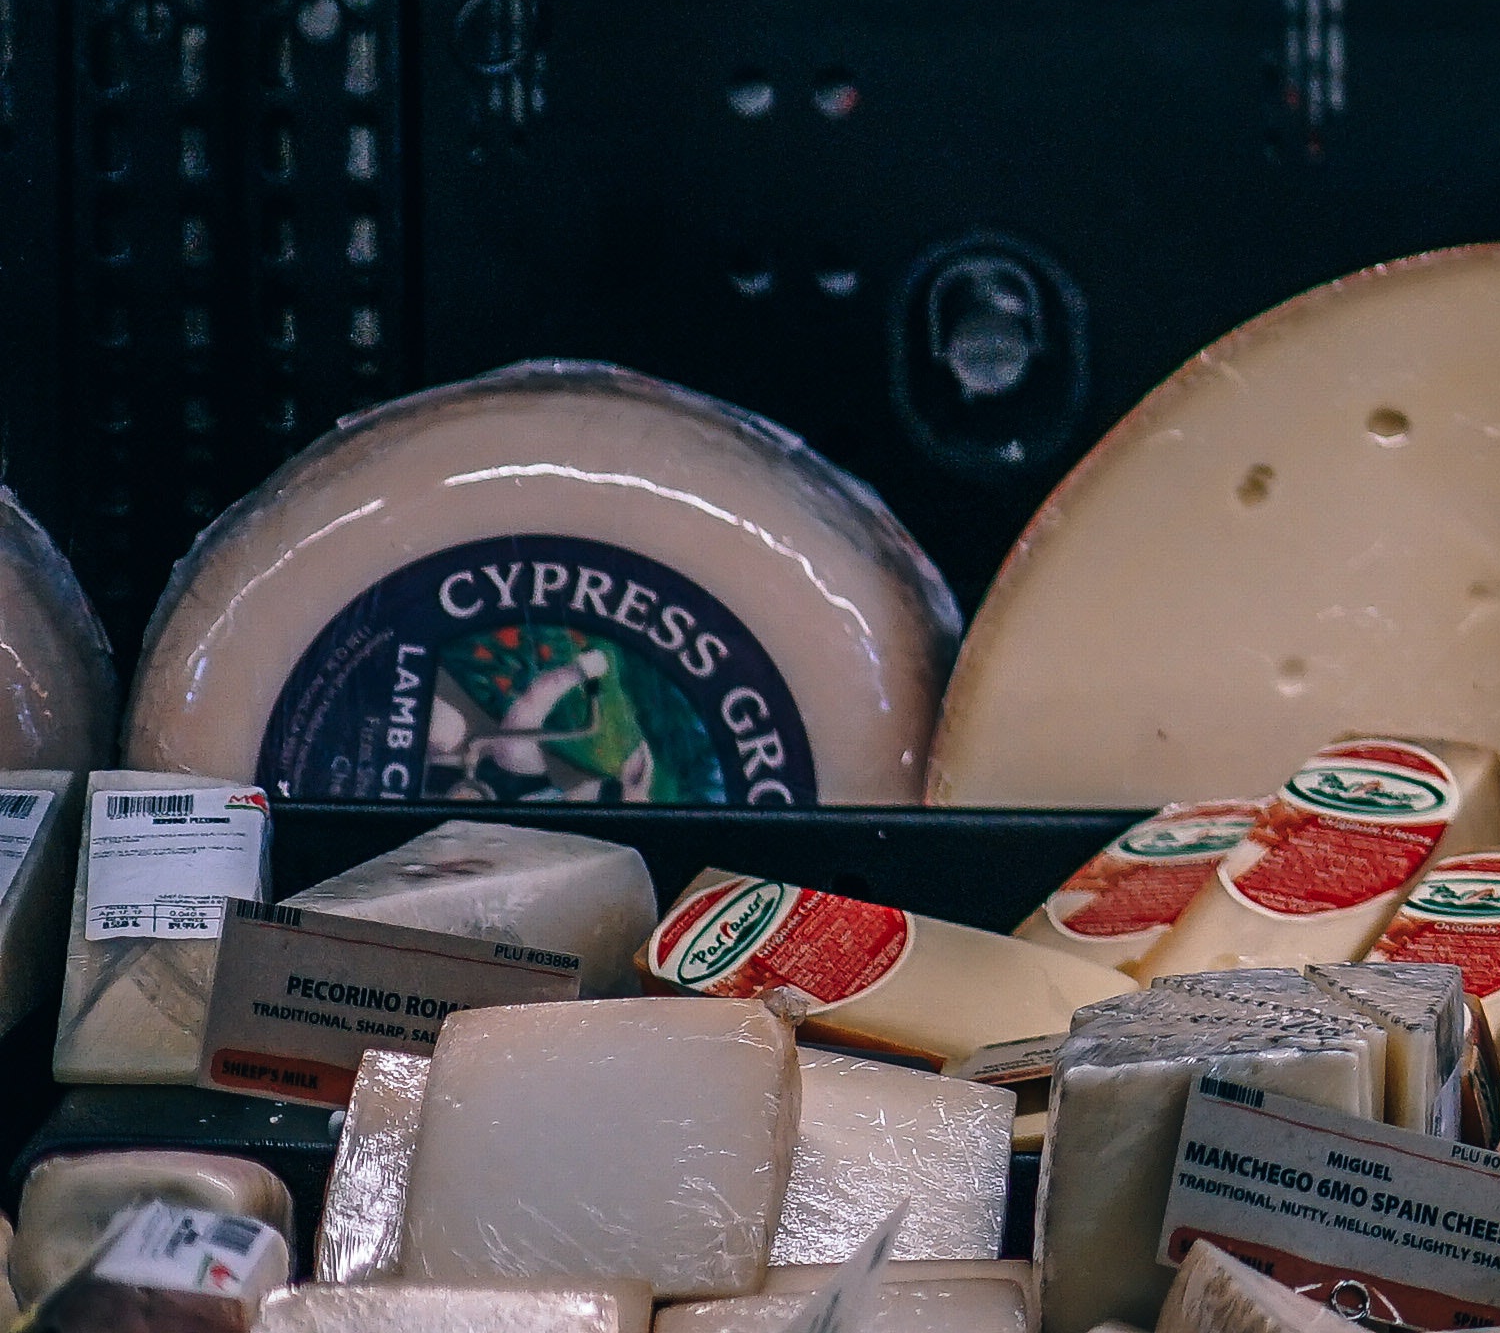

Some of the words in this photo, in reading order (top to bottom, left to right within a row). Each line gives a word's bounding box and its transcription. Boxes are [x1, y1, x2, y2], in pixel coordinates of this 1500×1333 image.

[439, 562, 731, 678] CYPRESS
[286, 973, 402, 1010] PECORINO
[1183, 1142, 1315, 1192] MANCHEGO
[1316, 1178, 1369, 1208] 6MO
[1370, 1192, 1440, 1228] SPAIN
[1326, 1150, 1393, 1183] MIGUEL
